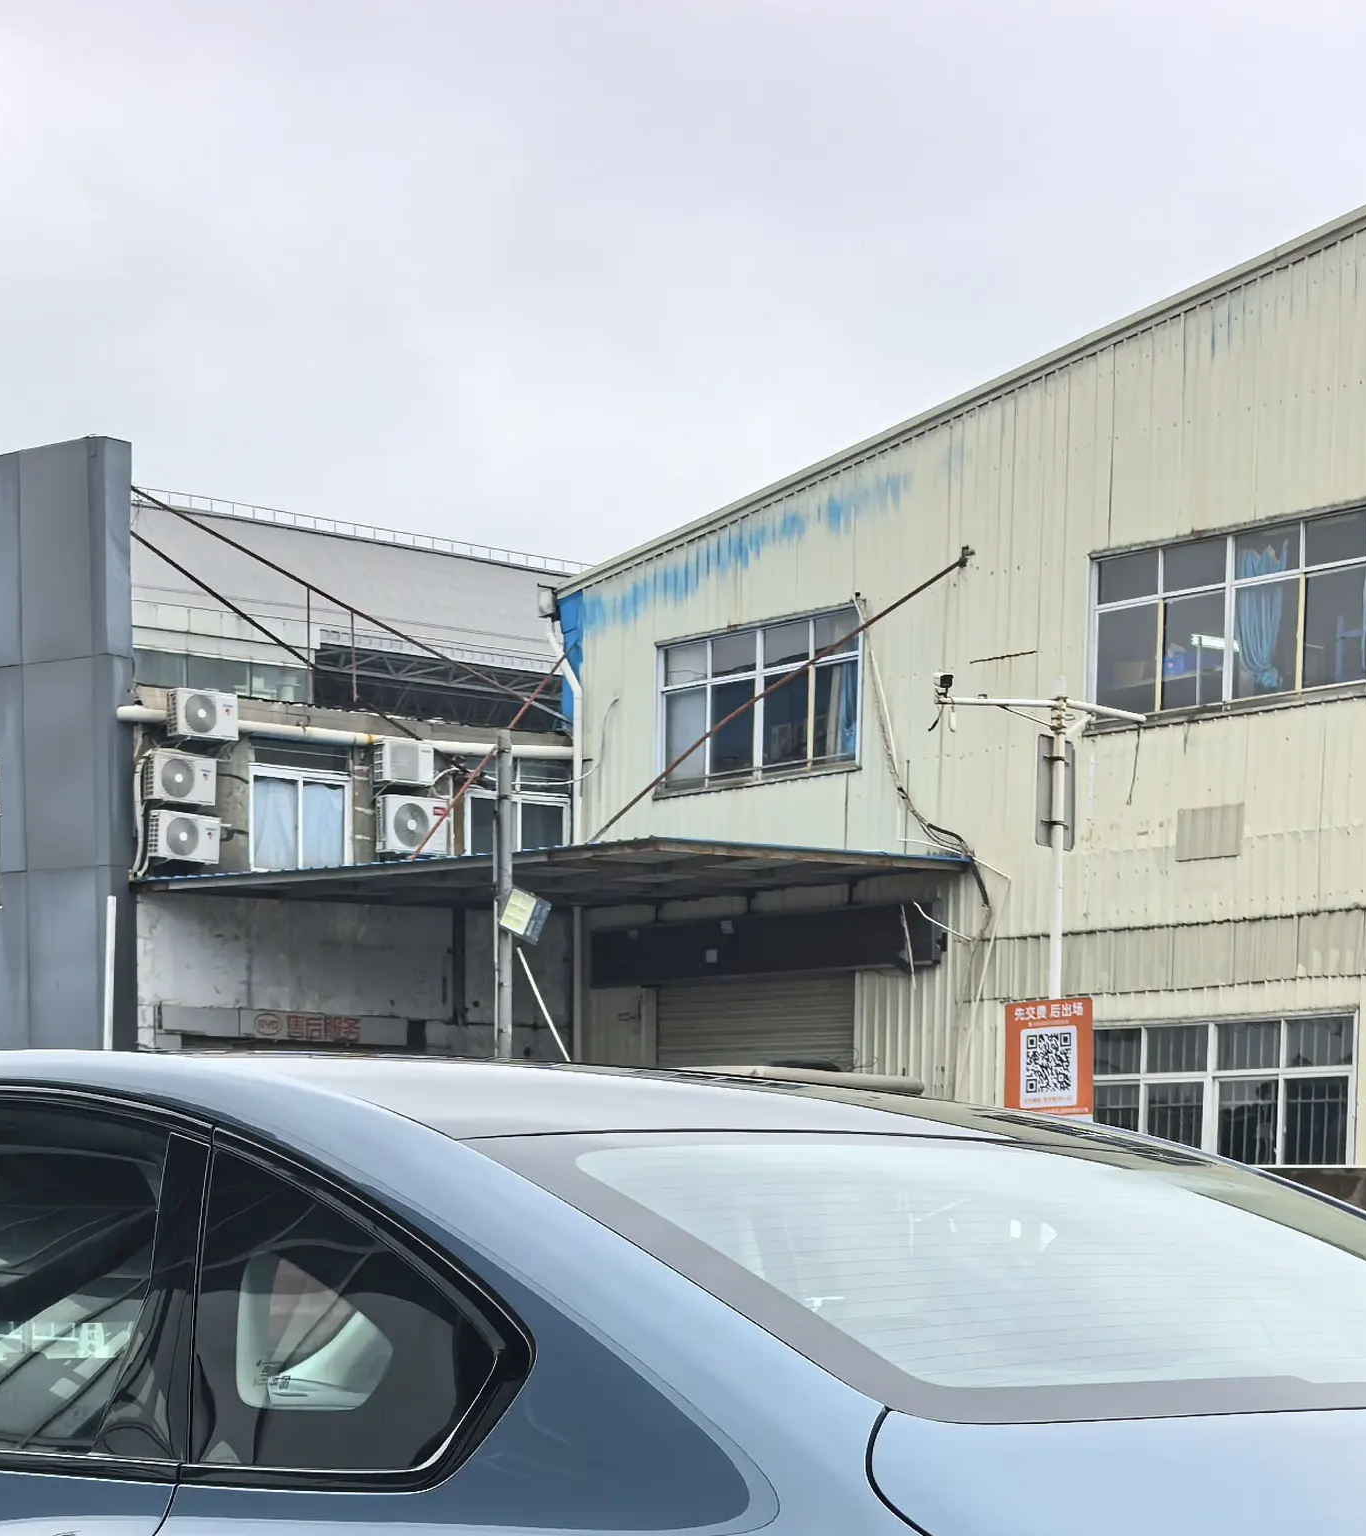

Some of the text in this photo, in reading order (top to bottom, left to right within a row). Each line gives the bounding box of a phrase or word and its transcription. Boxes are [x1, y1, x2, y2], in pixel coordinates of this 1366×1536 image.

[1014, 1002, 1084, 1021] 先交费 后出场
[287, 1014, 360, 1042] 售后服务
